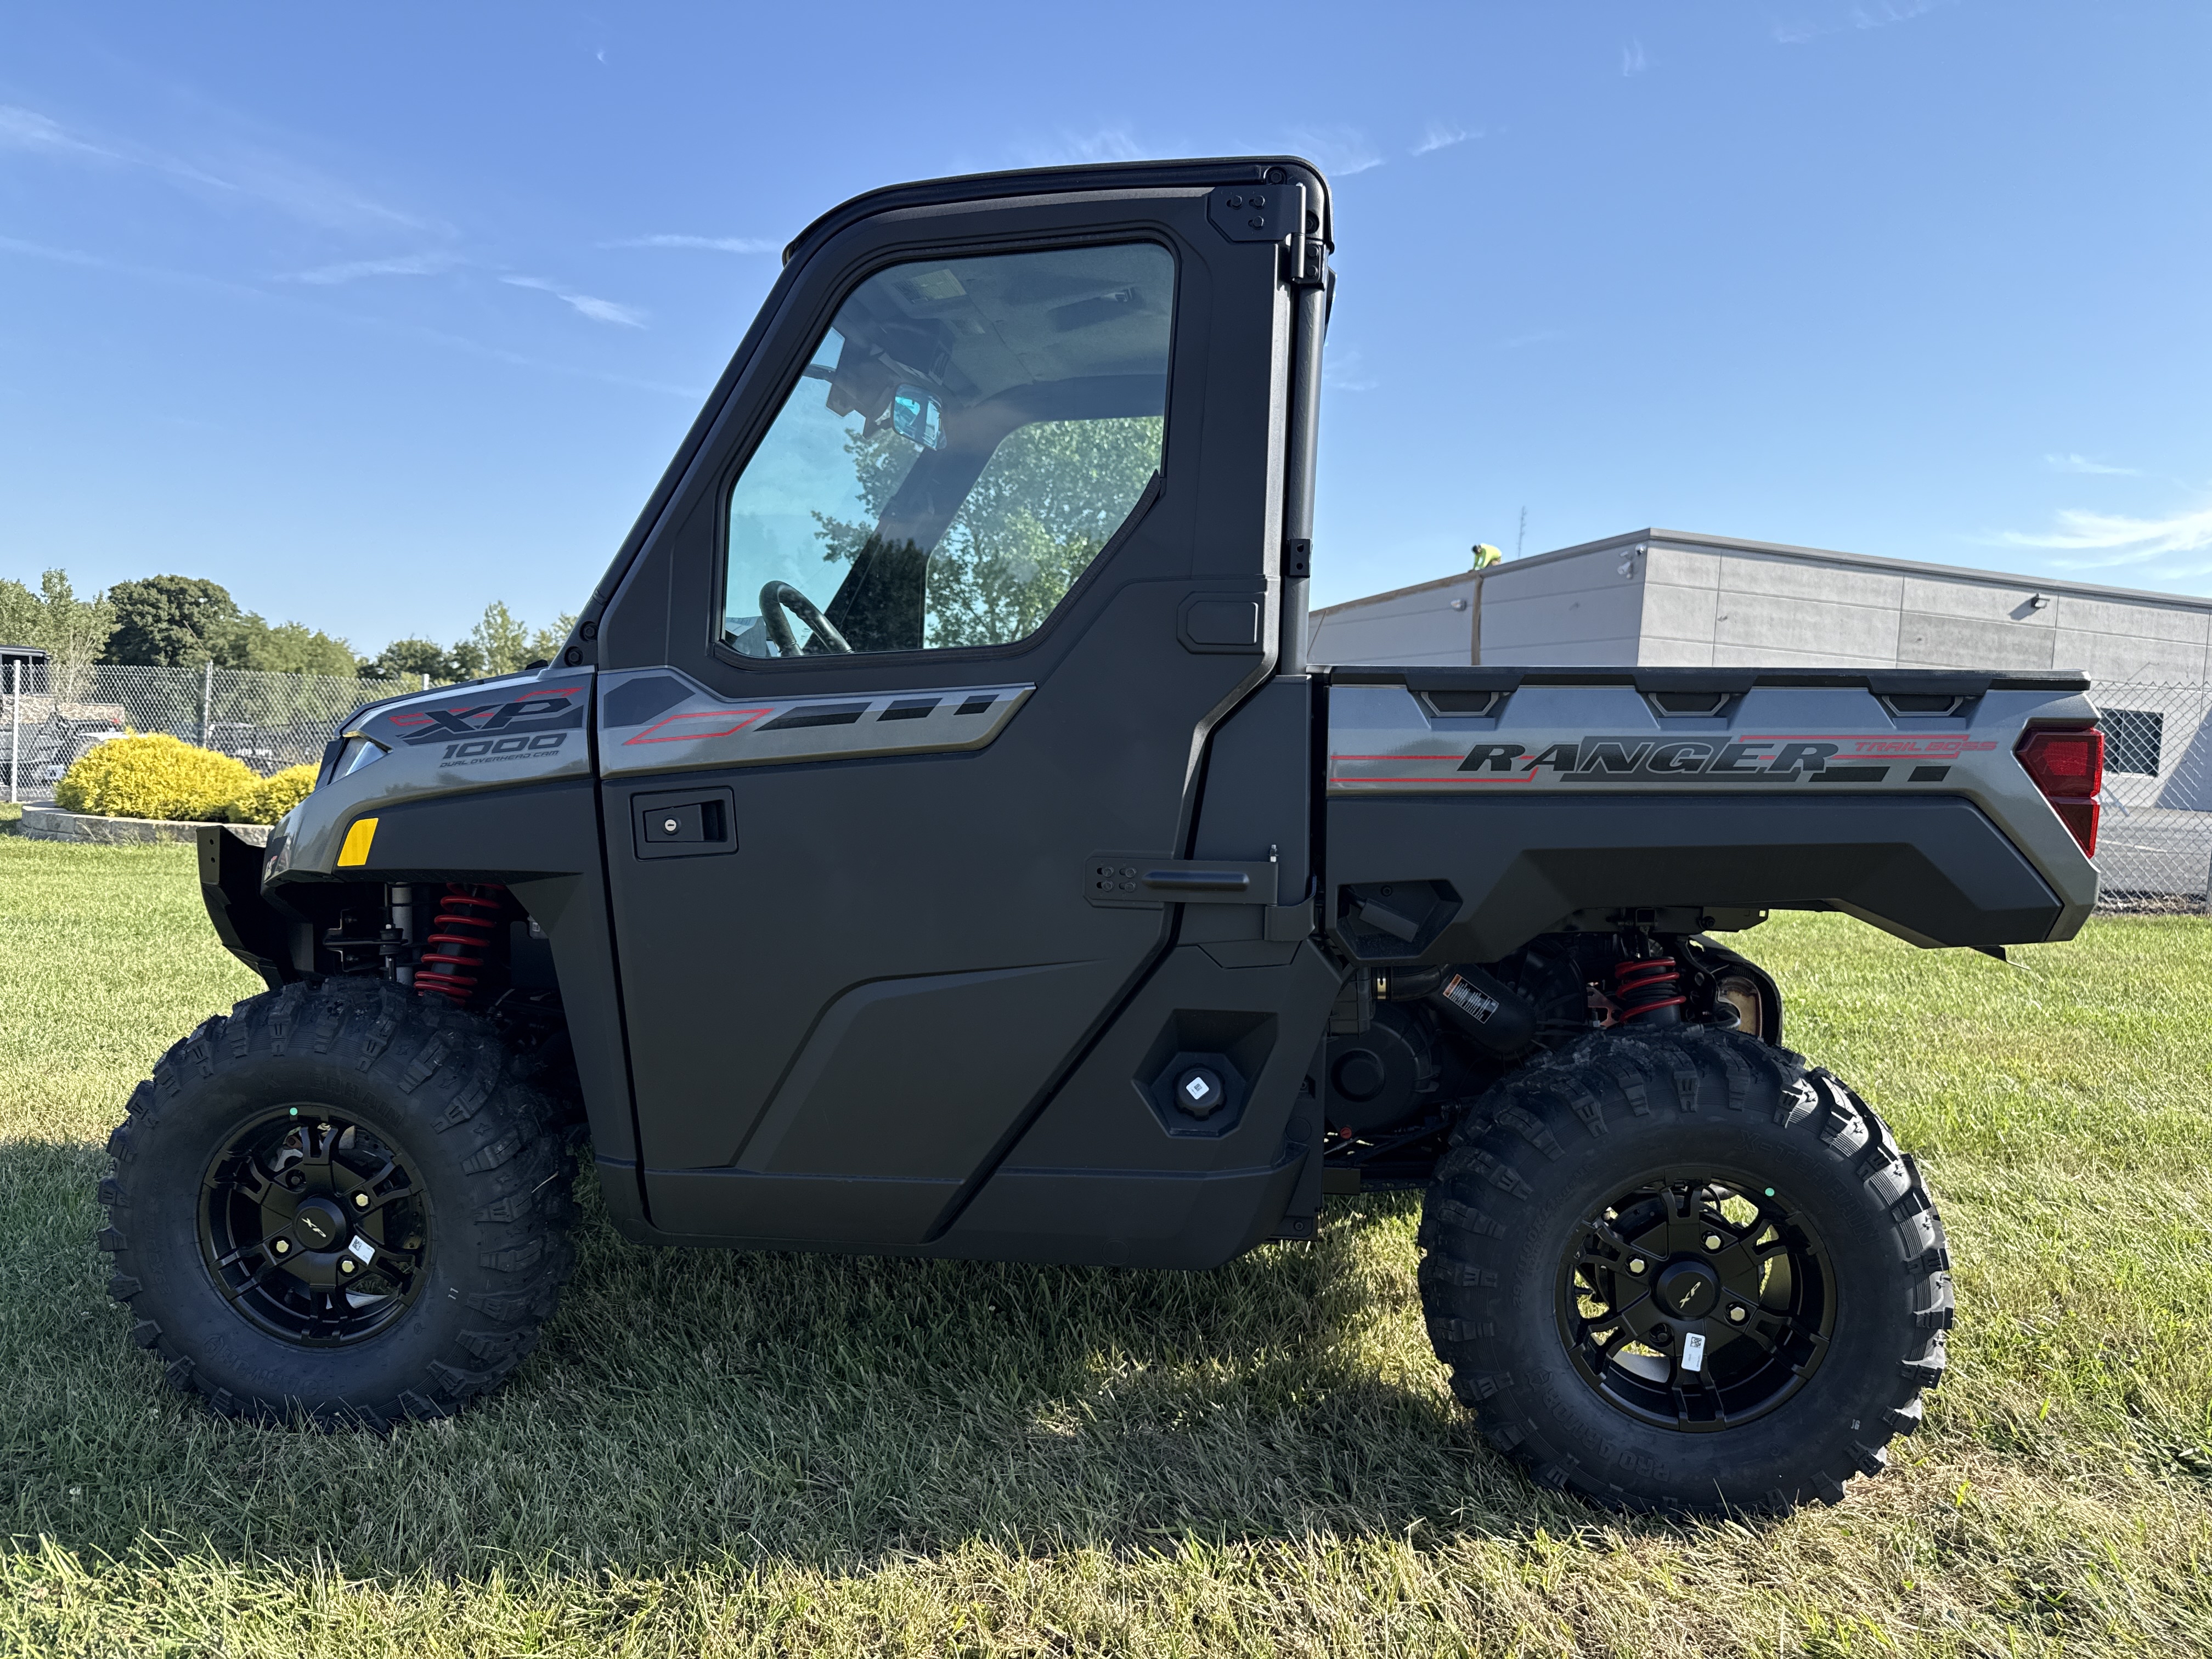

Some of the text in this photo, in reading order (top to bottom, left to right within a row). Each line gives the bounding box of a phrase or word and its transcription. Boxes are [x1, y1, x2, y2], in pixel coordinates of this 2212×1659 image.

[395, 698, 572, 739] XP
[440, 750, 560, 768] DUAL OVERHEAD CAM
[442, 733, 567, 759] 1000
[1457, 742, 1839, 772] RANGER
[1855, 741, 1998, 752] TRAIL BOSS
[1734, 1129, 1882, 1246] X-TERRAIN
[301, 1217, 326, 1238] XP
[1679, 1282, 1701, 1309] XP
[1542, 1387, 1671, 1482] PRO ARMOR
